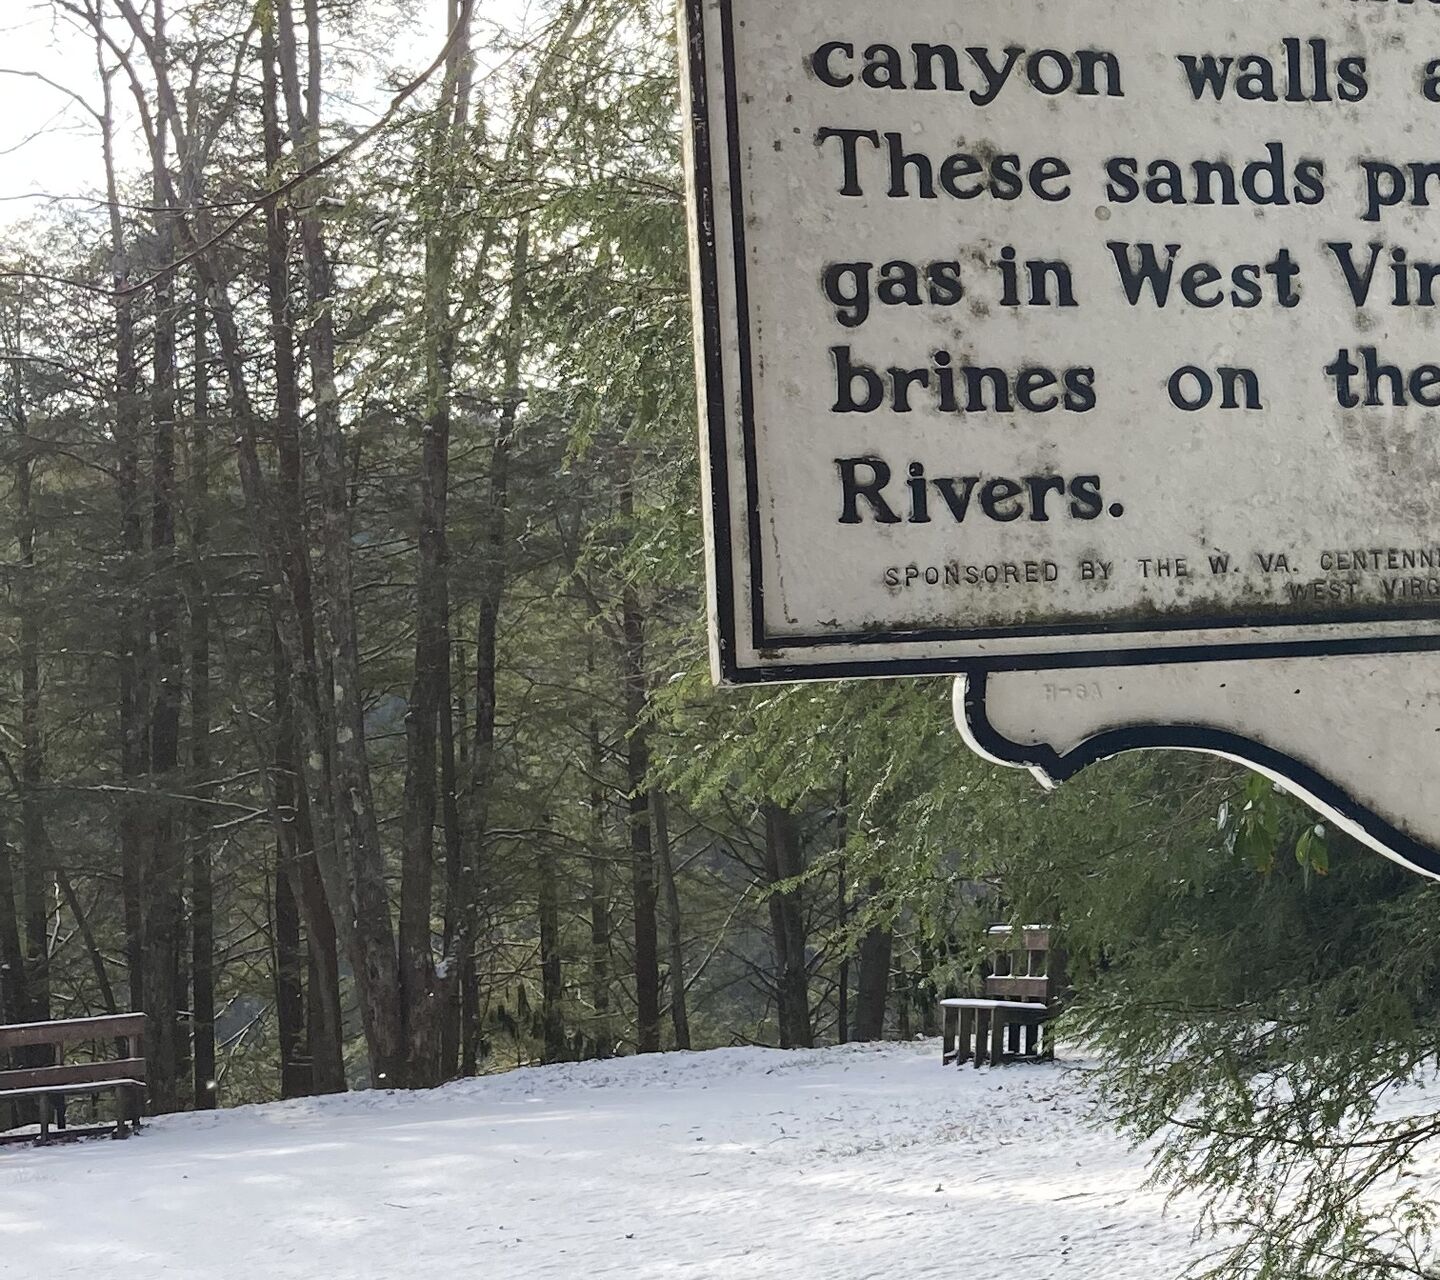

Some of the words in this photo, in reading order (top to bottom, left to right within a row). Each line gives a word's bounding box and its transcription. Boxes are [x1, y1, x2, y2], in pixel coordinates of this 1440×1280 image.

[811, 40, 1124, 106] canyon
[1177, 37, 1368, 104] walls
[816, 127, 1071, 202] These
[1105, 142, 1325, 206] sands
[823, 258, 964, 327] gas
[998, 246, 1079, 308] in
[1107, 241, 1301, 309] West
[827, 346, 1097, 414] brines
[1167, 364, 1264, 412] on
[835, 455, 1124, 524] Rivers.
[885, 561, 1059, 588] SPONSORED
[1080, 560, 1114, 581] BY
[1137, 557, 1188, 579] THE
[1207, 553, 1240, 574] W.
[1256, 553, 1299, 572] VA.
[1286, 580, 1358, 602] WEST
